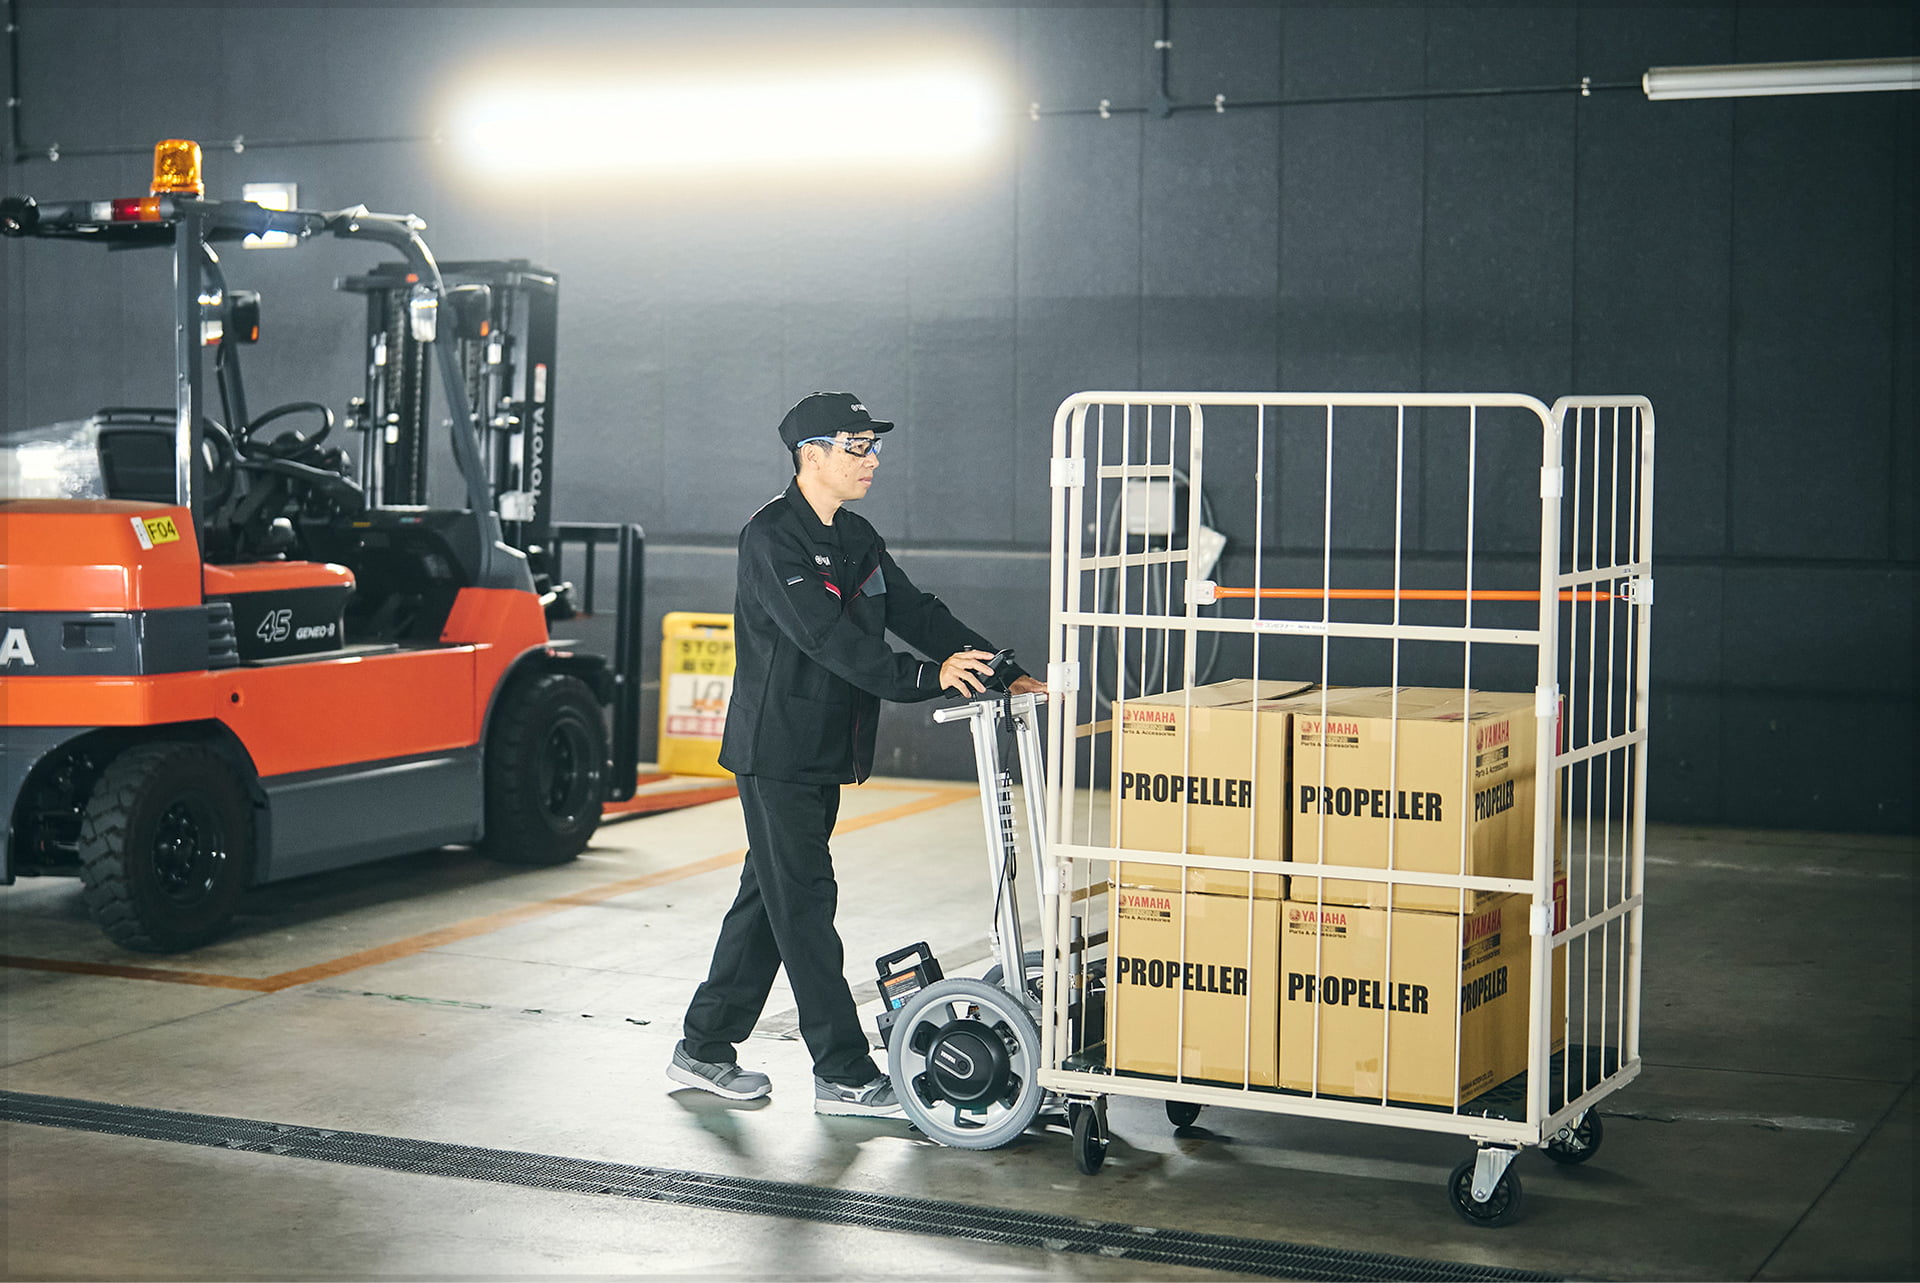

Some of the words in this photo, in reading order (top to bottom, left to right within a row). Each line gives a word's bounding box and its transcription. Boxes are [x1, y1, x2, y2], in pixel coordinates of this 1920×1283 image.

[147, 521, 176, 539] F04
[257, 609, 292, 642] 45
[0, 628, 36, 665] A
[681, 640, 731, 654] STOP
[1132, 710, 1176, 723] YAMAHA
[1313, 721, 1359, 735] YMAHA
[1484, 720, 1509, 749] YAMAHA
[1121, 771, 1252, 808] PROPELLER
[1300, 785, 1442, 822] PROPELLER
[1475, 779, 1514, 822] PROPELLER
[1127, 895, 1171, 910] YAMAHA
[1471, 907, 1502, 942] YAMAHA
[1116, 956, 1248, 996] PROPELLER
[1288, 972, 1429, 1014] PROPELLER
[1460, 965, 1508, 1017] PROPELLER
